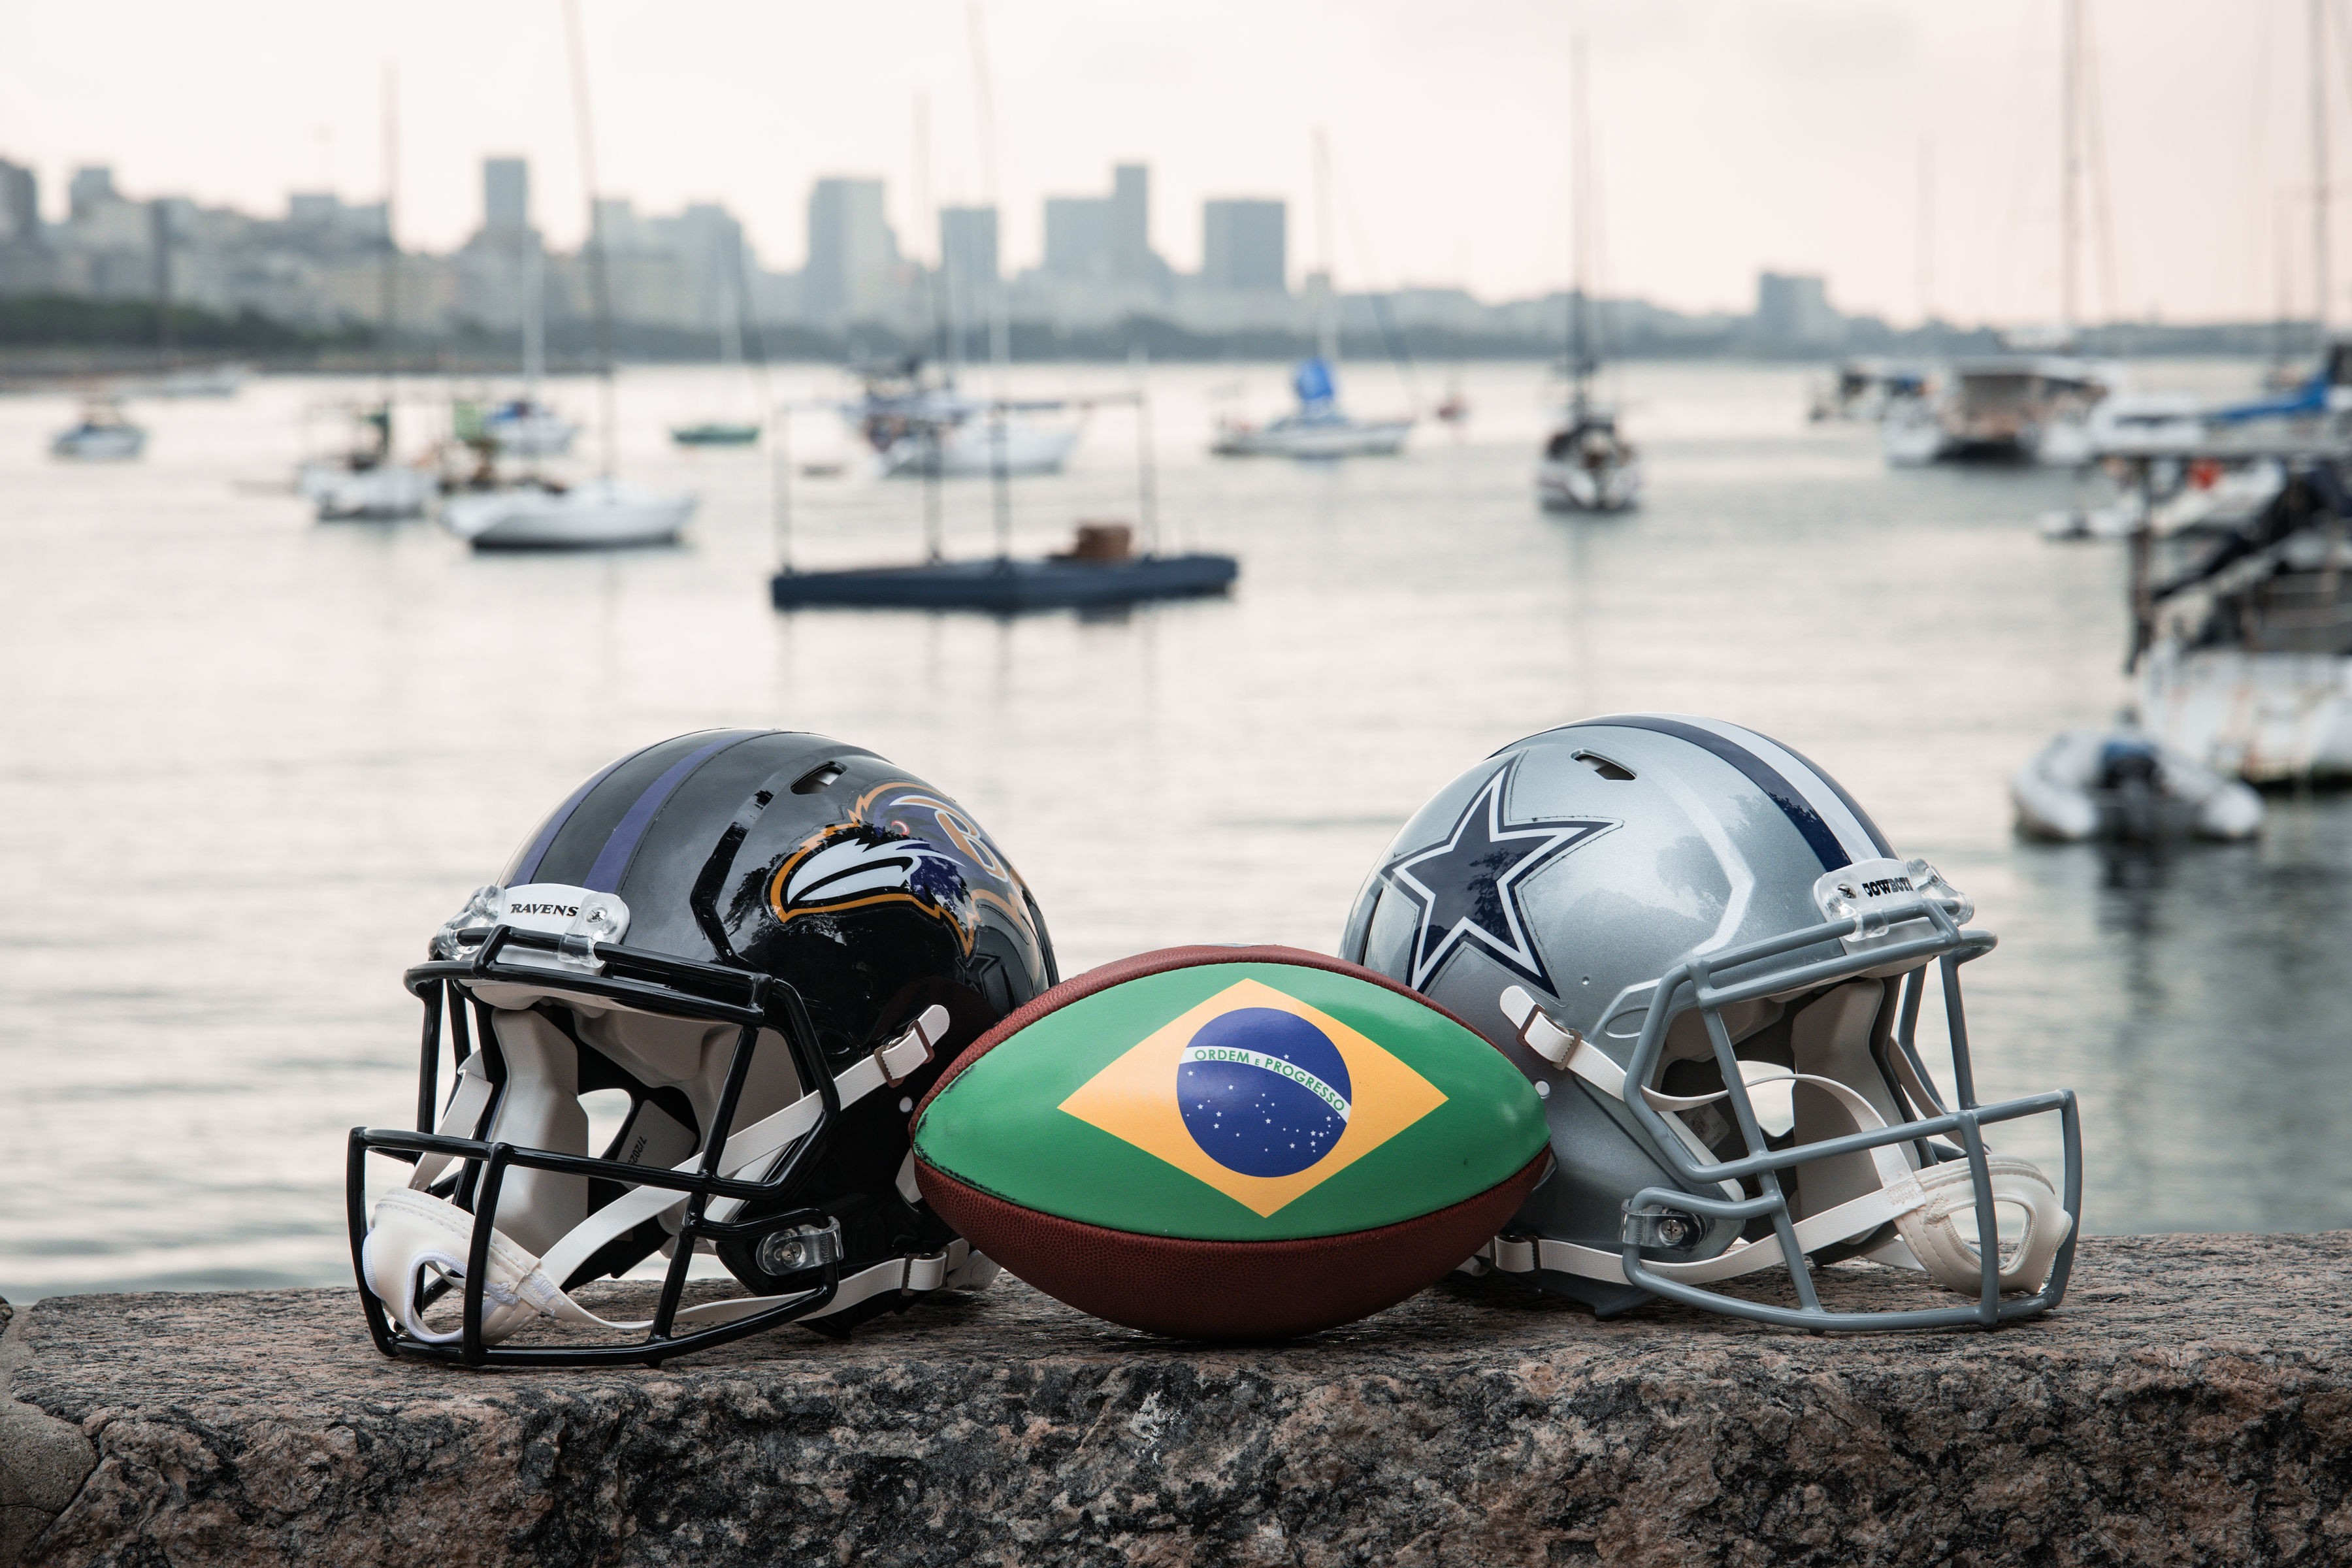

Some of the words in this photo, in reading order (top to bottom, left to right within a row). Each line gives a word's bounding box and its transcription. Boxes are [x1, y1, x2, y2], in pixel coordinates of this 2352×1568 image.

[1861, 877, 1914, 897] COWBOYS
[510, 904, 579, 916] RAVENS
[1195, 1049, 1249, 1063] ORDEM
[1265, 1058, 1345, 1111] PROGRESSO
